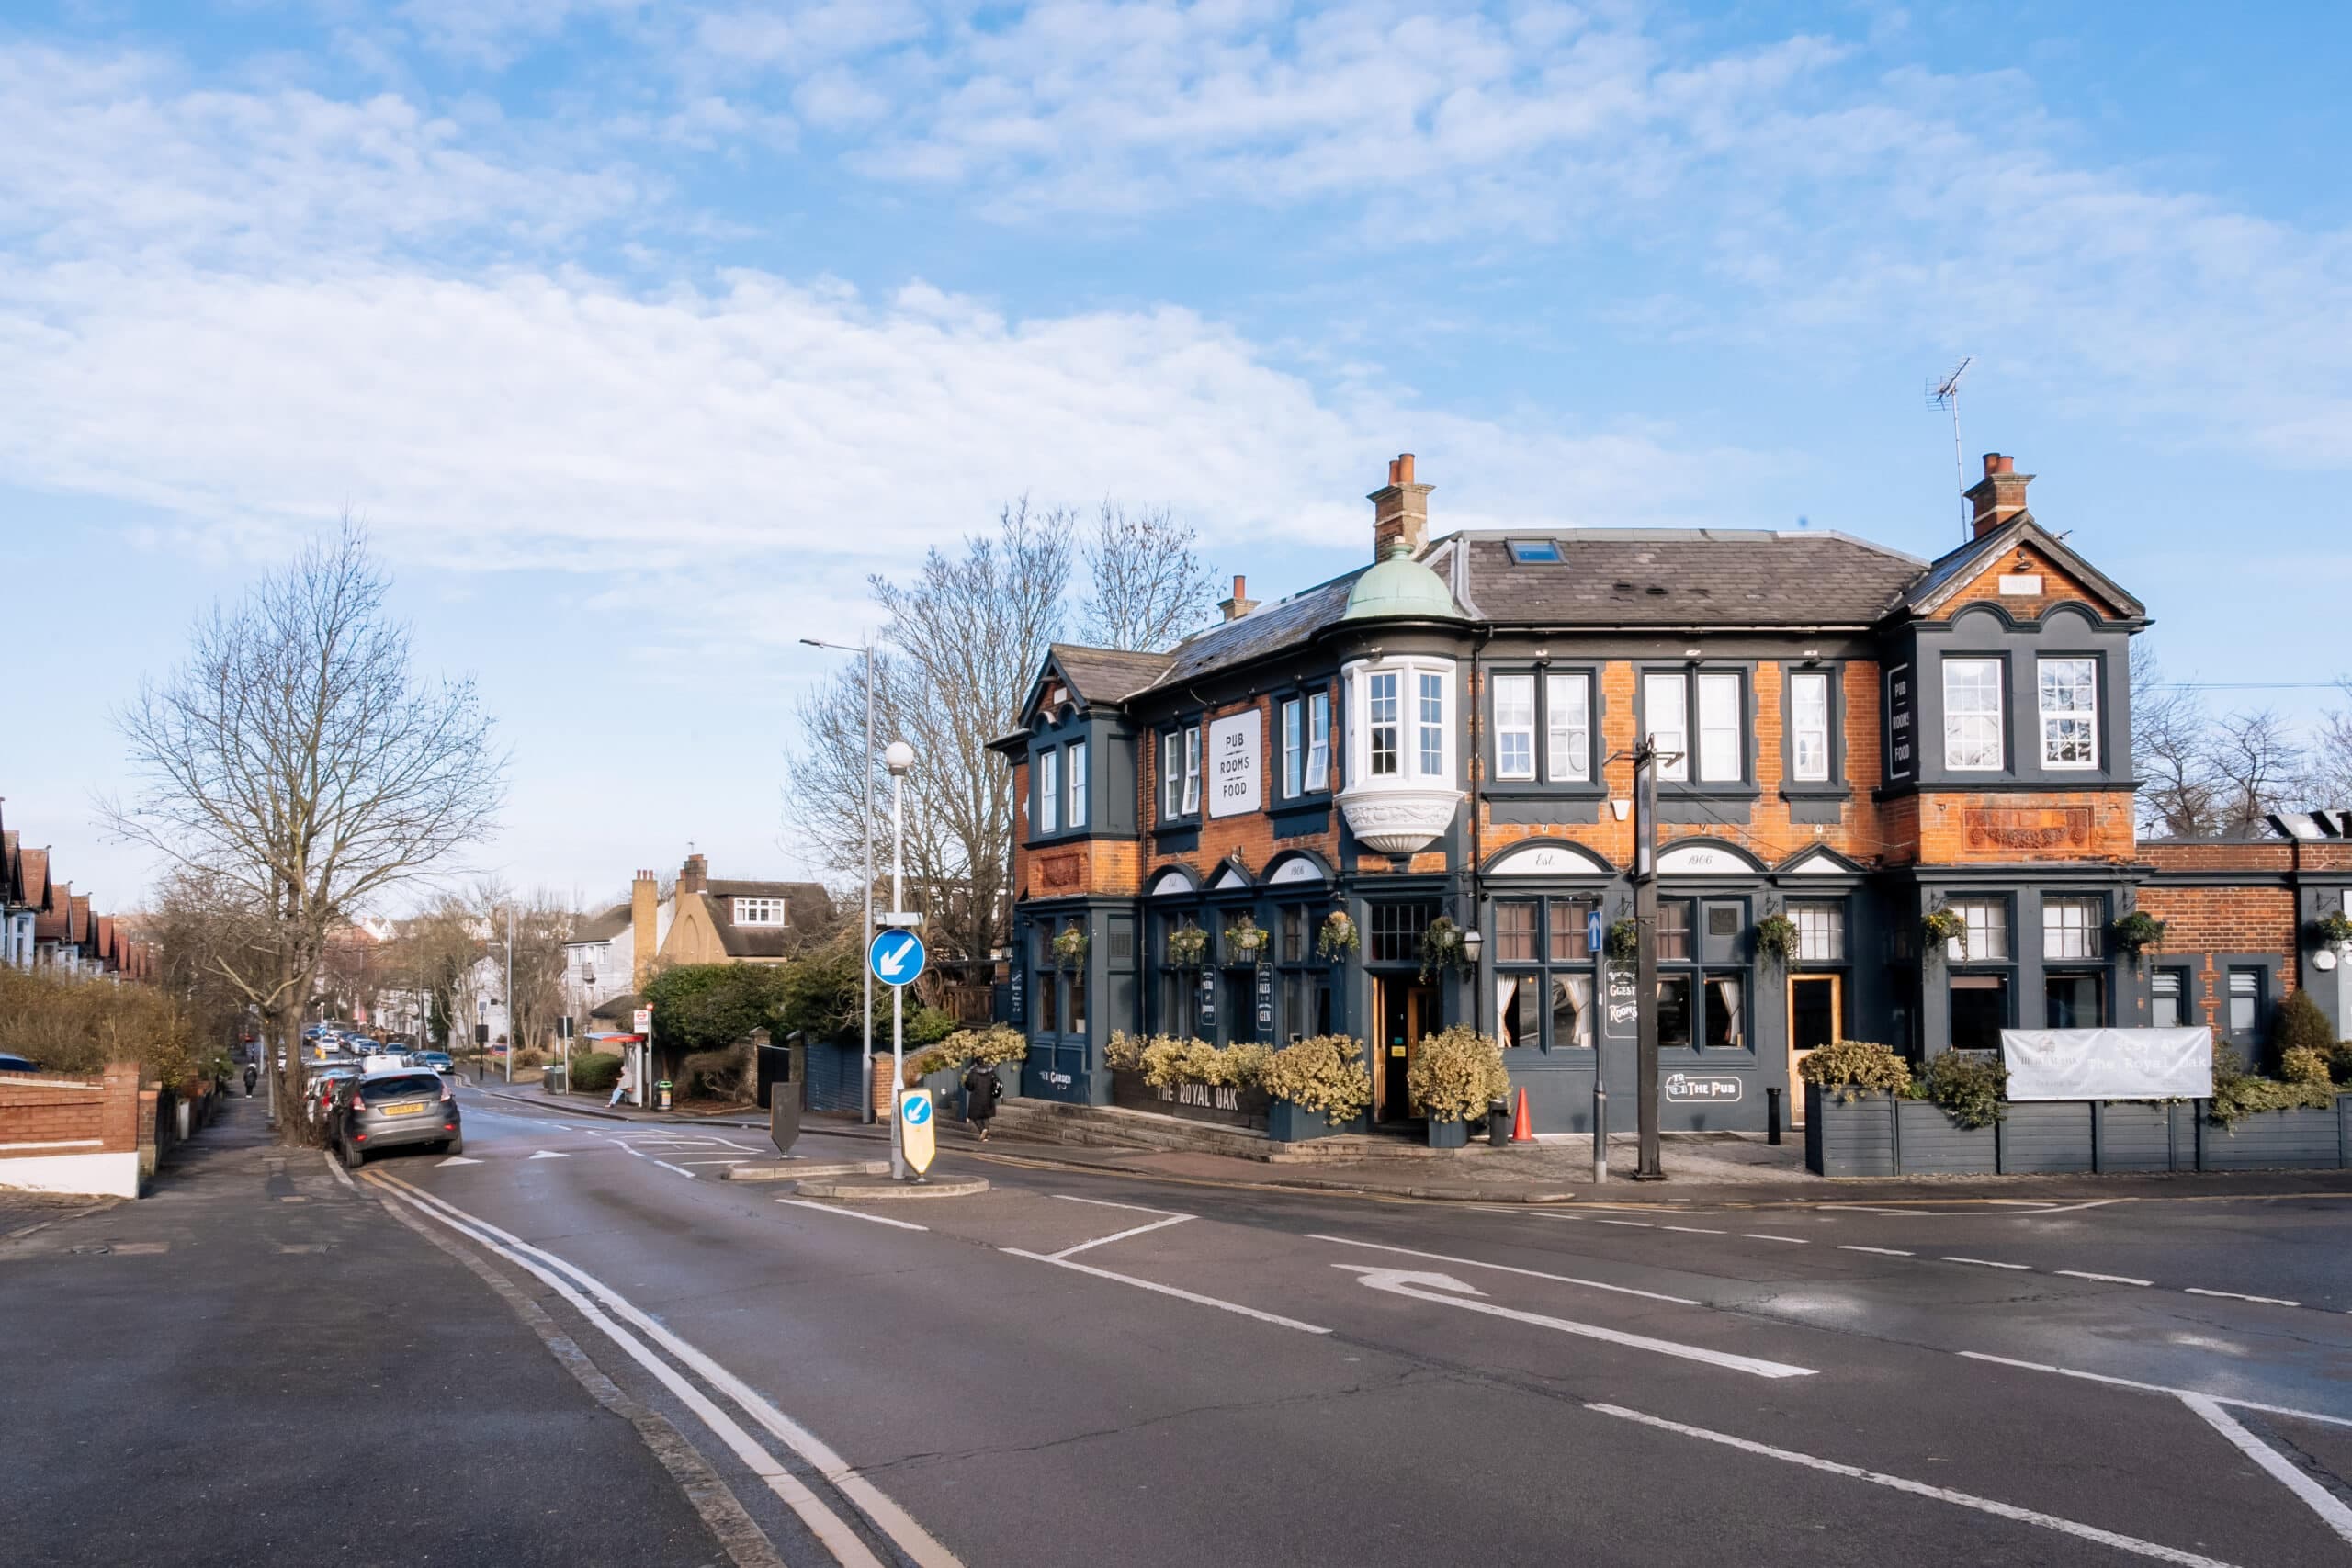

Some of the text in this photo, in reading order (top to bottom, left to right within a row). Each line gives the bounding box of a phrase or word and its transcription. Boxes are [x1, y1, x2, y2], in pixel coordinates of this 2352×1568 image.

[1894, 681, 1906, 698] PUB
[1893, 712, 1909, 730] ROOMS
[1226, 733, 1244, 750] PUB
[1894, 744, 1910, 762] FOOD
[1220, 756, 1250, 774] ROOMS
[1223, 782, 1247, 798] FOOD
[1688, 854, 1713, 865] 1906
[1157, 1082, 1238, 1111] THE ROYAL OAK
[1687, 1081, 1736, 1097] THE PUB
